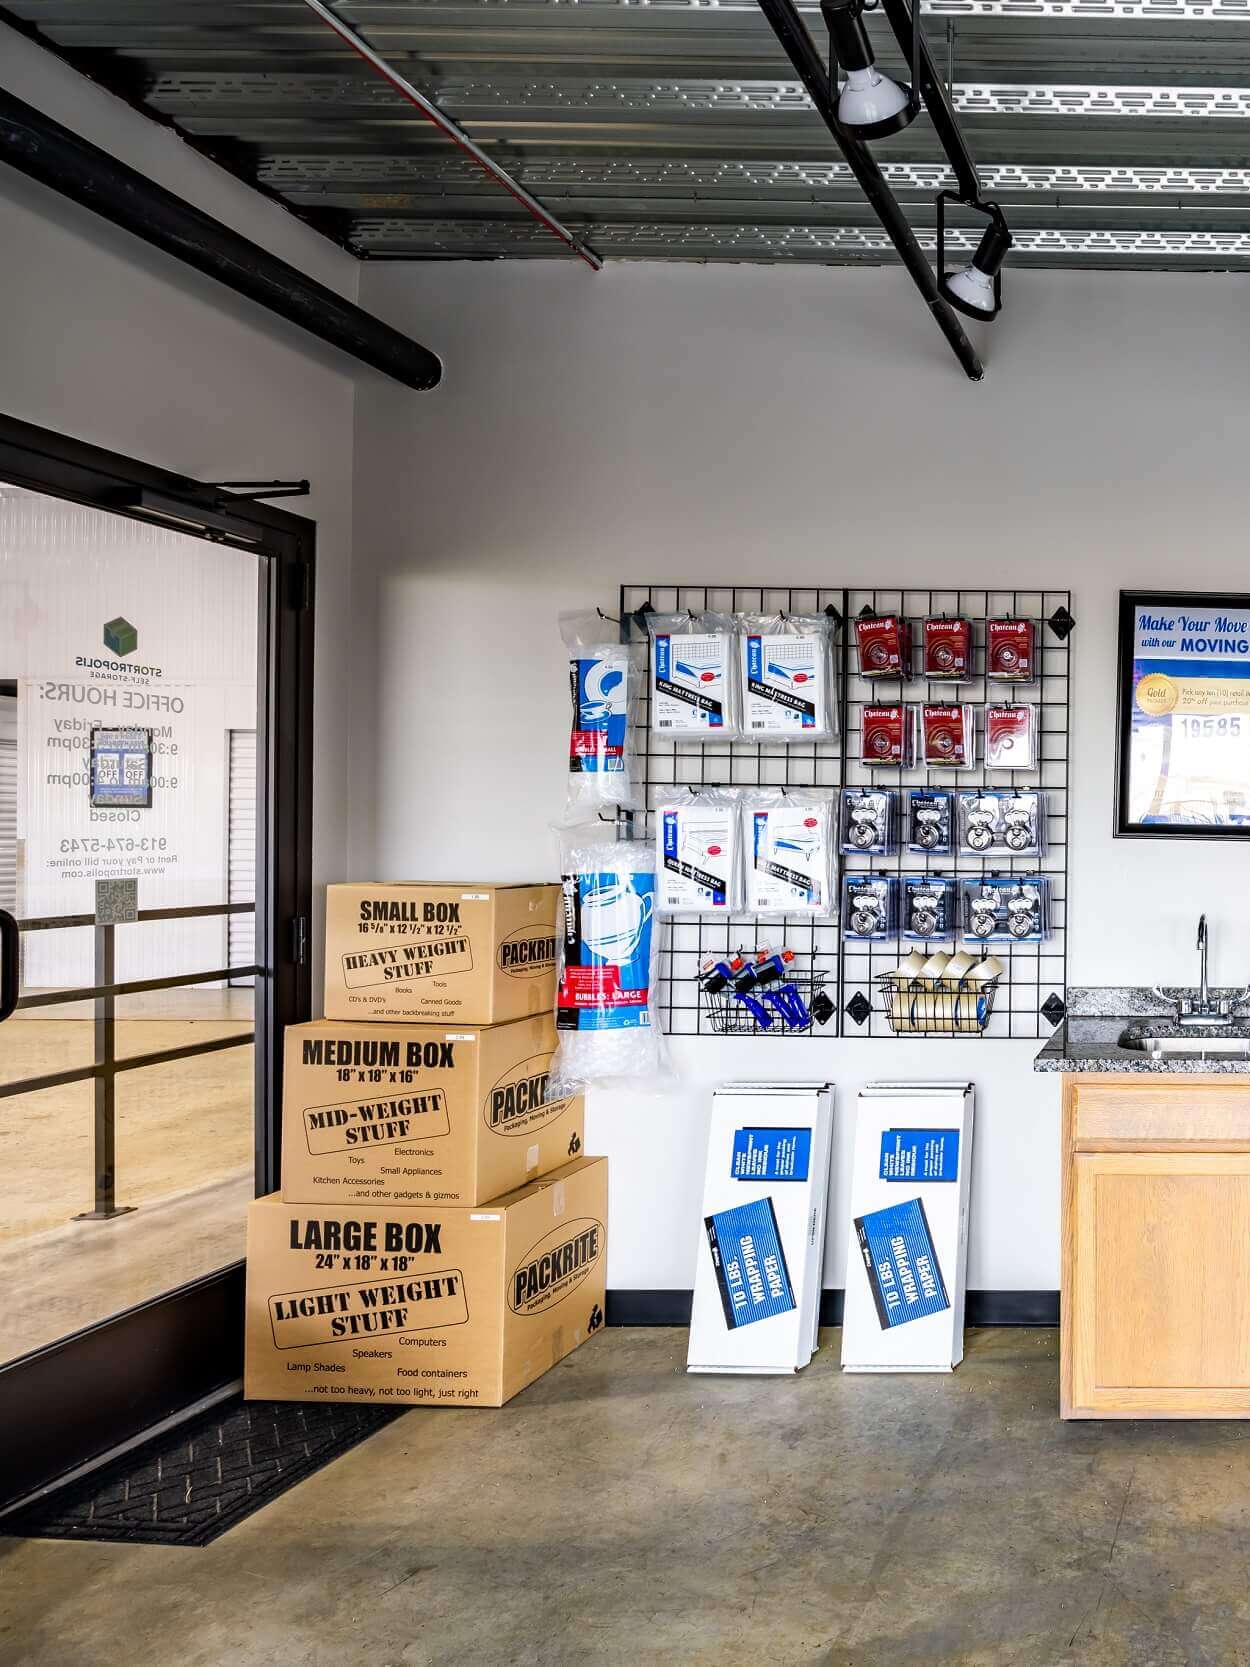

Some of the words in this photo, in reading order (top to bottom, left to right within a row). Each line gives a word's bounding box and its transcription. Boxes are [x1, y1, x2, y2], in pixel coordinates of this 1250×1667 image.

[1138, 615, 1175, 631] Make
[1177, 616, 1211, 632] Your
[1215, 616, 1247, 633] Move
[1141, 637, 1160, 648] with
[1161, 639, 1176, 648] our
[1180, 638, 1249, 654] MOVING
[1147, 688, 1167, 698] Gold
[360, 900, 418, 923] SMALL
[424, 902, 460, 923] BOX
[358, 923, 369, 934] 16
[397, 923, 407, 934] 12
[434, 924, 444, 935] 12
[345, 949, 398, 970] HEAVY
[403, 939, 467, 961] WEIGHT
[501, 936, 557, 969] PACKRIT
[384, 960, 433, 980] STUFF
[443, 998, 462, 1006] Goods
[402, 1009, 440, 1017] backbreaking
[302, 1040, 400, 1067] MEDIUM
[406, 1042, 455, 1068] BOX
[336, 1068, 356, 1082] 18"
[358, 1071, 365, 1081] x
[368, 1069, 388, 1083] 18"
[390, 1072, 397, 1082] x
[400, 1069, 419, 1083] 16"
[308, 1094, 442, 1131] MID-WEIGHT
[345, 1120, 411, 1145] STUFF
[348, 1156, 365, 1165] Toys
[394, 1148, 434, 1156] Electronics
[313, 1176, 340, 1184] Kitchen
[342, 1177, 385, 1185] Accessories
[380, 1167, 400, 1175] Small
[402, 1167, 442, 1177] Appliances
[375, 1190, 392, 1198] other
[394, 1190, 423, 1200] gadgets
[425, 1191, 431, 1199] &
[433, 1192, 460, 1201] gizmos
[289, 1220, 377, 1251] LARGE
[385, 1222, 442, 1253] BOX
[316, 1254, 340, 1269] 24"
[342, 1257, 351, 1270] x
[355, 1255, 377, 1270] 18"
[380, 1259, 388, 1270] x
[392, 1256, 415, 1272] 18"
[514, 1223, 599, 1311] PACKRITE
[727, 1254, 743, 1289] LBS.
[740, 1235, 766, 1305] WRAPPING
[879, 1255, 896, 1289] LBS.
[890, 1235, 919, 1306] WRAPPING
[764, 1254, 784, 1298] PAPER
[916, 1255, 937, 1299] PAPER
[274, 1293, 351, 1321] LIGHT
[358, 1276, 459, 1308] WEIGHT
[332, 1308, 408, 1337] STUFF
[399, 1337, 447, 1348] Computers
[352, 1349, 392, 1360] Speakers
[287, 1363, 312, 1373] Lamp
[314, 1363, 346, 1373] Shades
[397, 1368, 419, 1377] Food
[420, 1368, 468, 1378] containers
[329, 1386, 346, 1394] too
[348, 1386, 376, 1397] heavy,
[378, 1388, 393, 1396] not
[395, 1388, 411, 1396] too
[413, 1388, 435, 1399] light,
[437, 1388, 456, 1399] just
[458, 1388, 479, 1399] right
